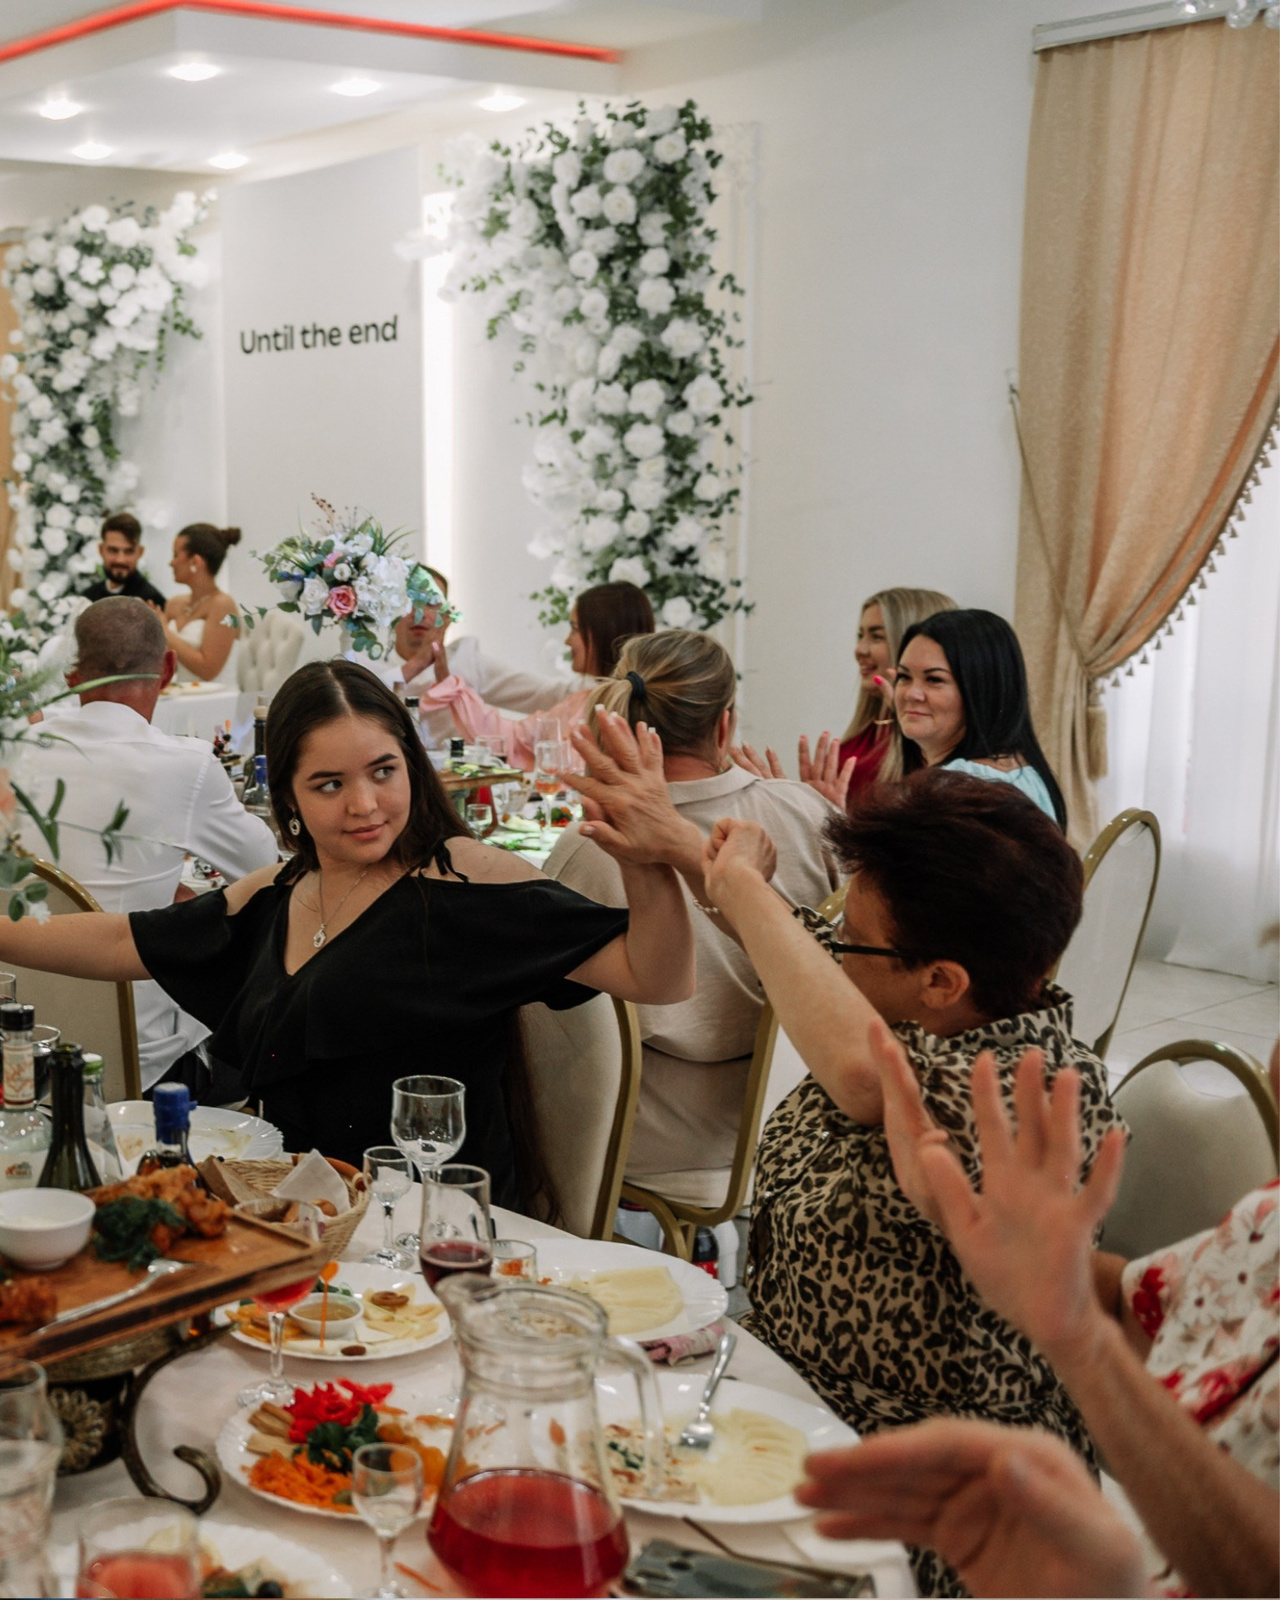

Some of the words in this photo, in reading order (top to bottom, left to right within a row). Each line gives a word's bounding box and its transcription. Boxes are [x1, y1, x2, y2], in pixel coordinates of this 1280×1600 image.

[240, 324, 295, 354] Until
[300, 322, 342, 349] the
[348, 314, 399, 345] end
